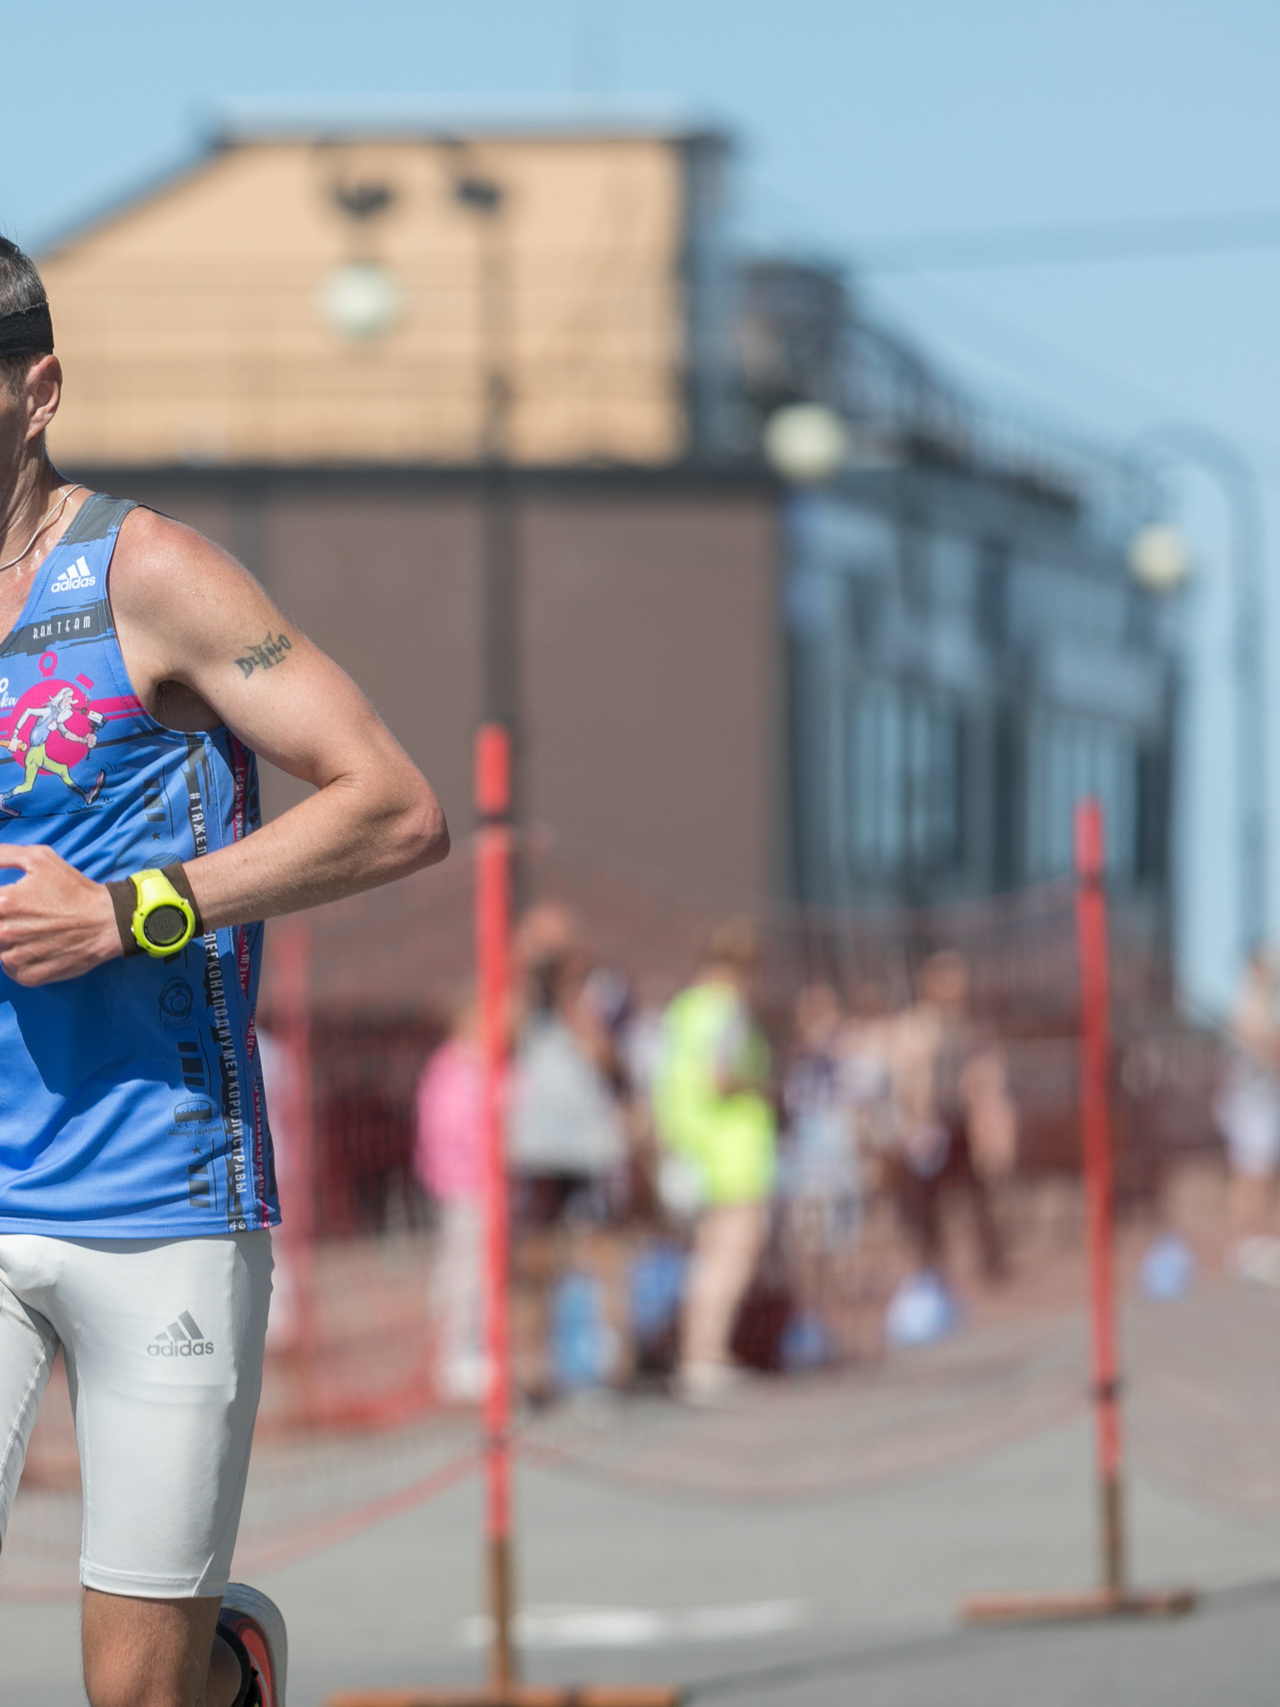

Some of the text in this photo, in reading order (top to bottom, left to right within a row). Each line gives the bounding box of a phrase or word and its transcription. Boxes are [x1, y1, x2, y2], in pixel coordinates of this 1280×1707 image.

[51, 575, 96, 593] adidas
[57, 615, 91, 634] TEAM
[229, 1220, 247, 1231] 46
[147, 1340, 215, 1357] adidas
